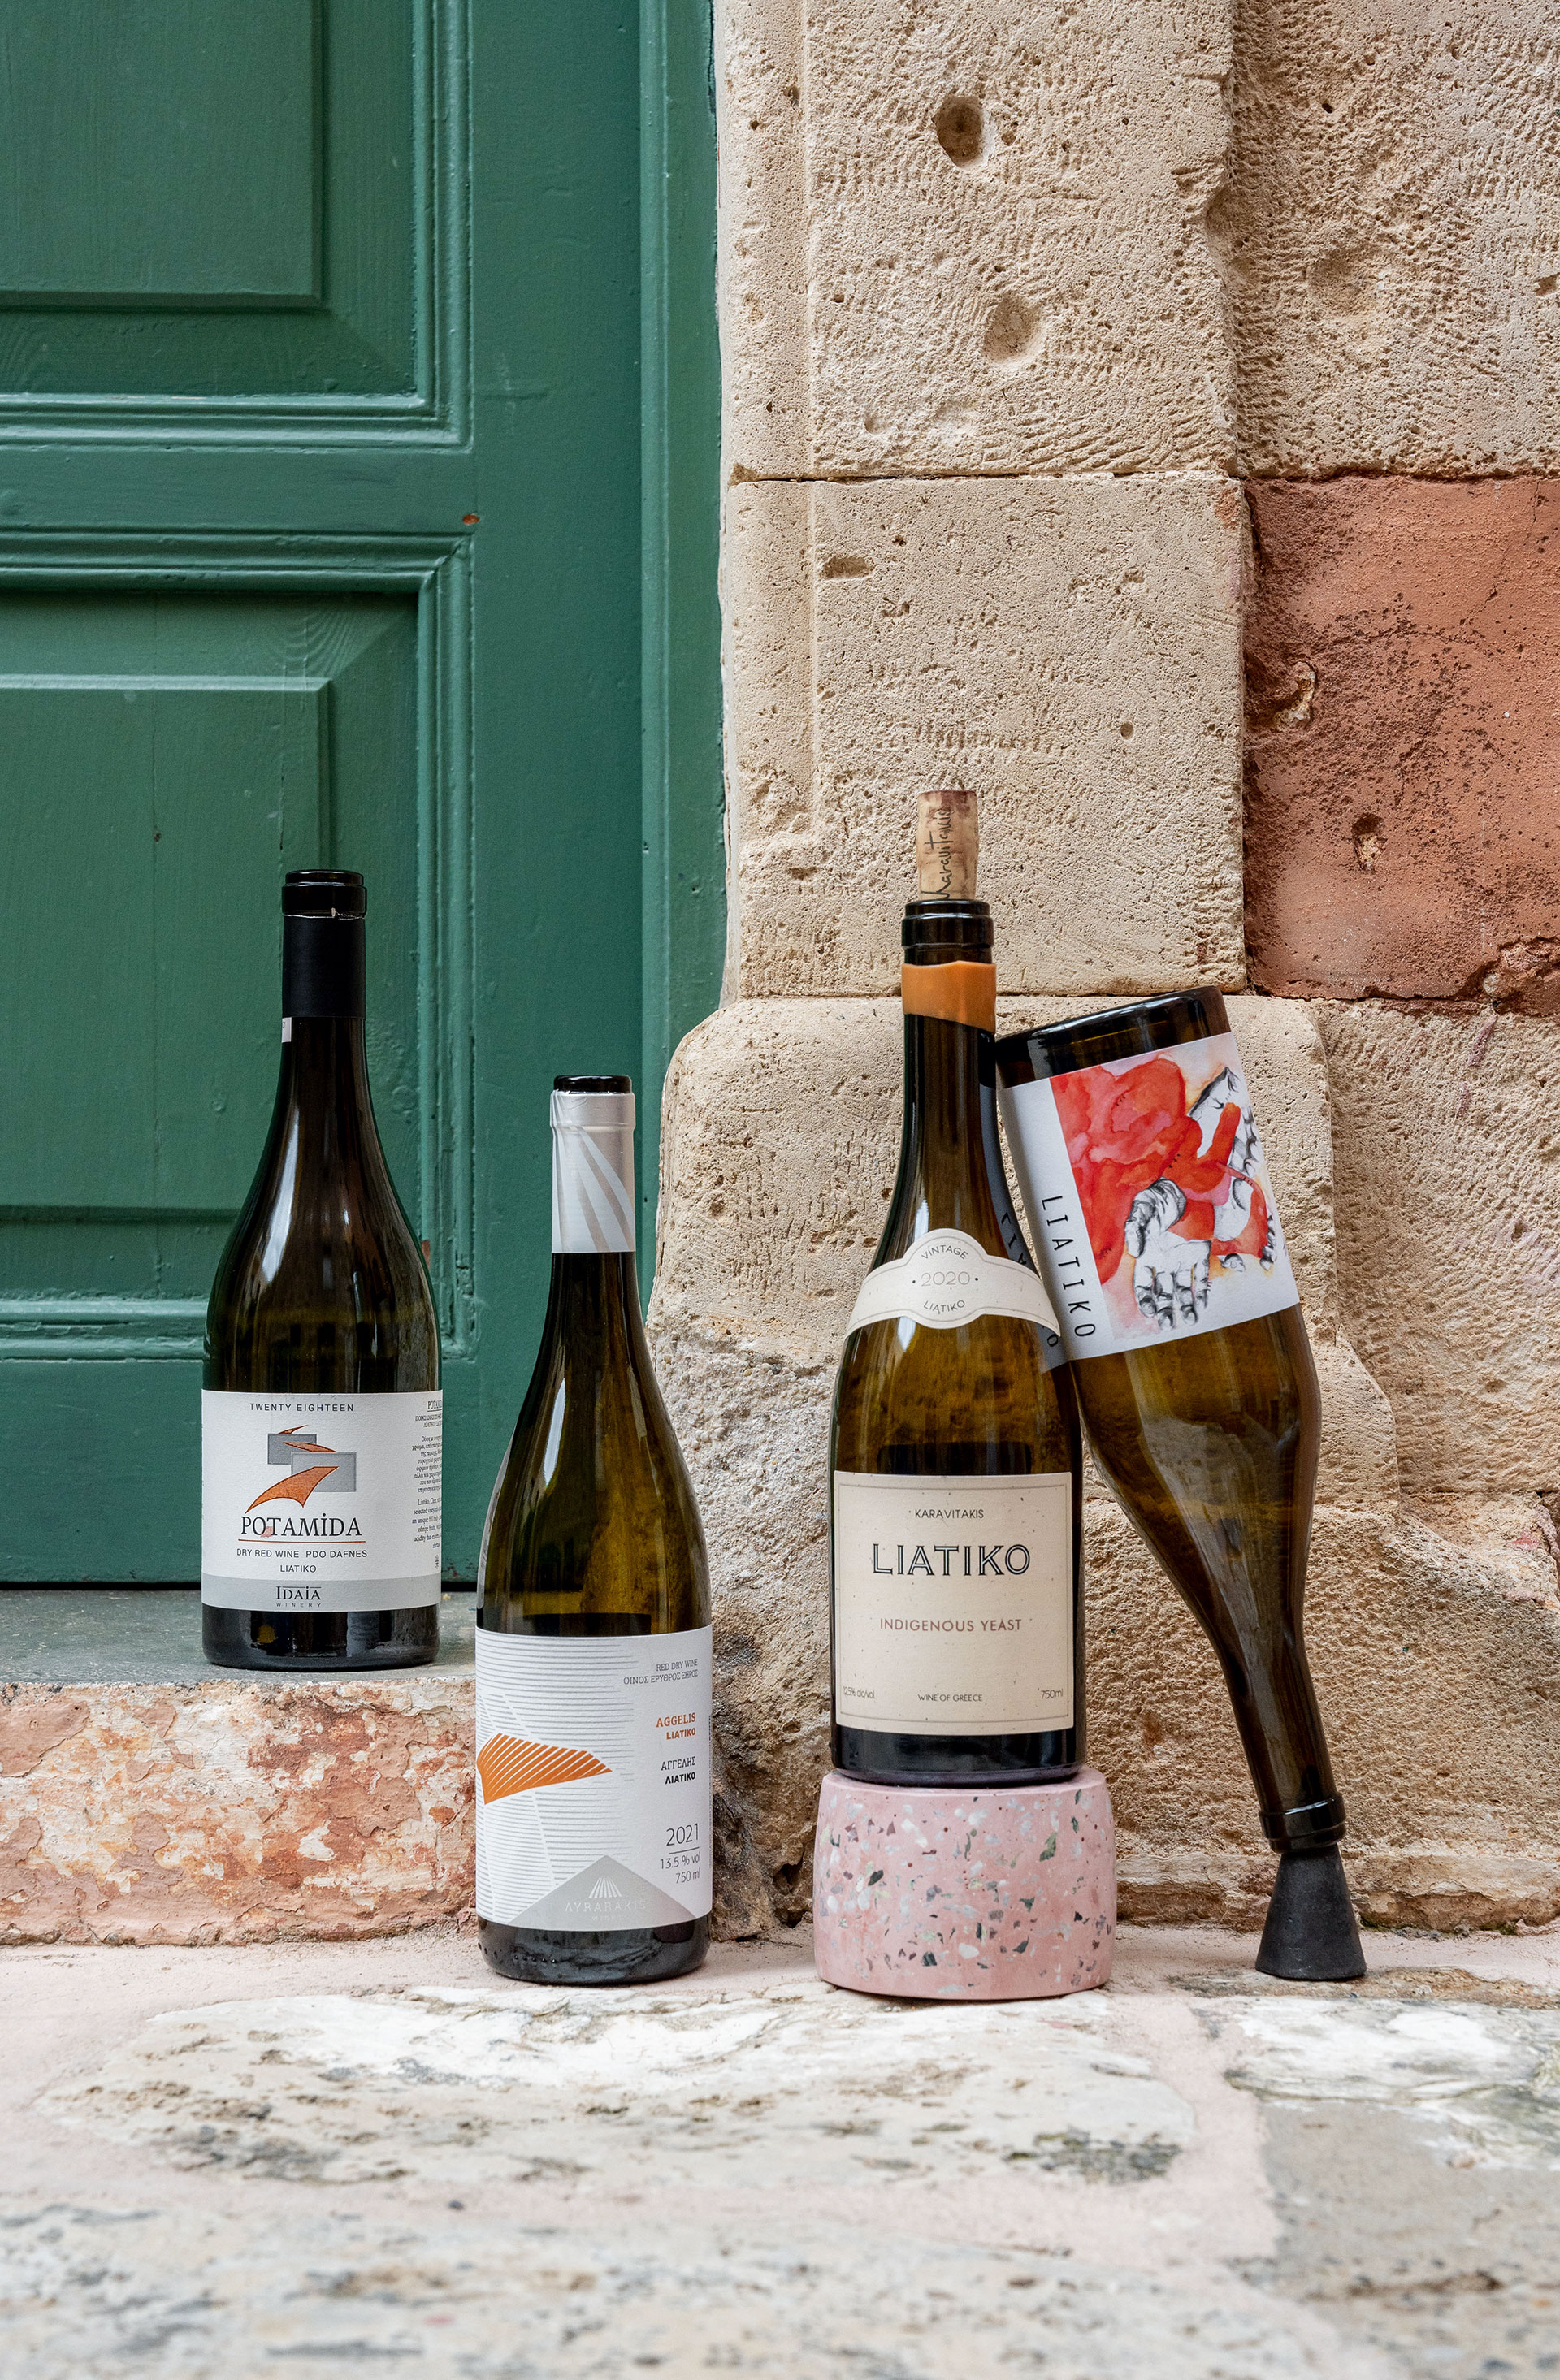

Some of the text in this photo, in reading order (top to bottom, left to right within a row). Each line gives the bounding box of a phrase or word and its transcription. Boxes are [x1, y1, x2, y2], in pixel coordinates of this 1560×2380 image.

[921, 1244, 968, 1260] VINTAGE
[1041, 1195, 1095, 1338] LIATIKO
[921, 1271, 970, 1286] 2020
[924, 1300, 965, 1313] LIATIKO
[250, 1403, 354, 1412] TWENTY EIGHTEEN
[915, 1509, 984, 1519] KARAVITAKIS
[236, 1548, 252, 1556] DRY
[255, 1549, 272, 1557] RED
[275, 1550, 299, 1558] WINE
[330, 1550, 367, 1558] DAFNES
[873, 1544, 1030, 1576] LIATIKO
[280, 1564, 316, 1573] LIATIKO
[880, 1618, 1021, 1632] INDIGENOUS YEAST
[671, 1661, 683, 1670] DRY
[685, 1659, 698, 1668] WINE
[624, 1676, 648, 1685] ΟΙΝΟΣ
[651, 1672, 680, 1683] ΕΡΥΘΡΟΣ
[918, 1694, 938, 1702] WINE
[939, 1694, 951, 1702] OF
[952, 1694, 982, 1702] GREECE
[1041, 1689, 1064, 1699] 750ml
[656, 1713, 696, 1728] AGGELIS
[666, 1728, 696, 1740] LIATIKO
[661, 1756, 696, 1771] ΑΓΓΕΛΗΣ
[665, 1772, 696, 1785] ΛΙΑΤΙΚΟ
[666, 1824, 699, 1846] 2021
[660, 1852, 700, 1869] 13.5 % vol
[675, 1869, 700, 1884] 750 ml
